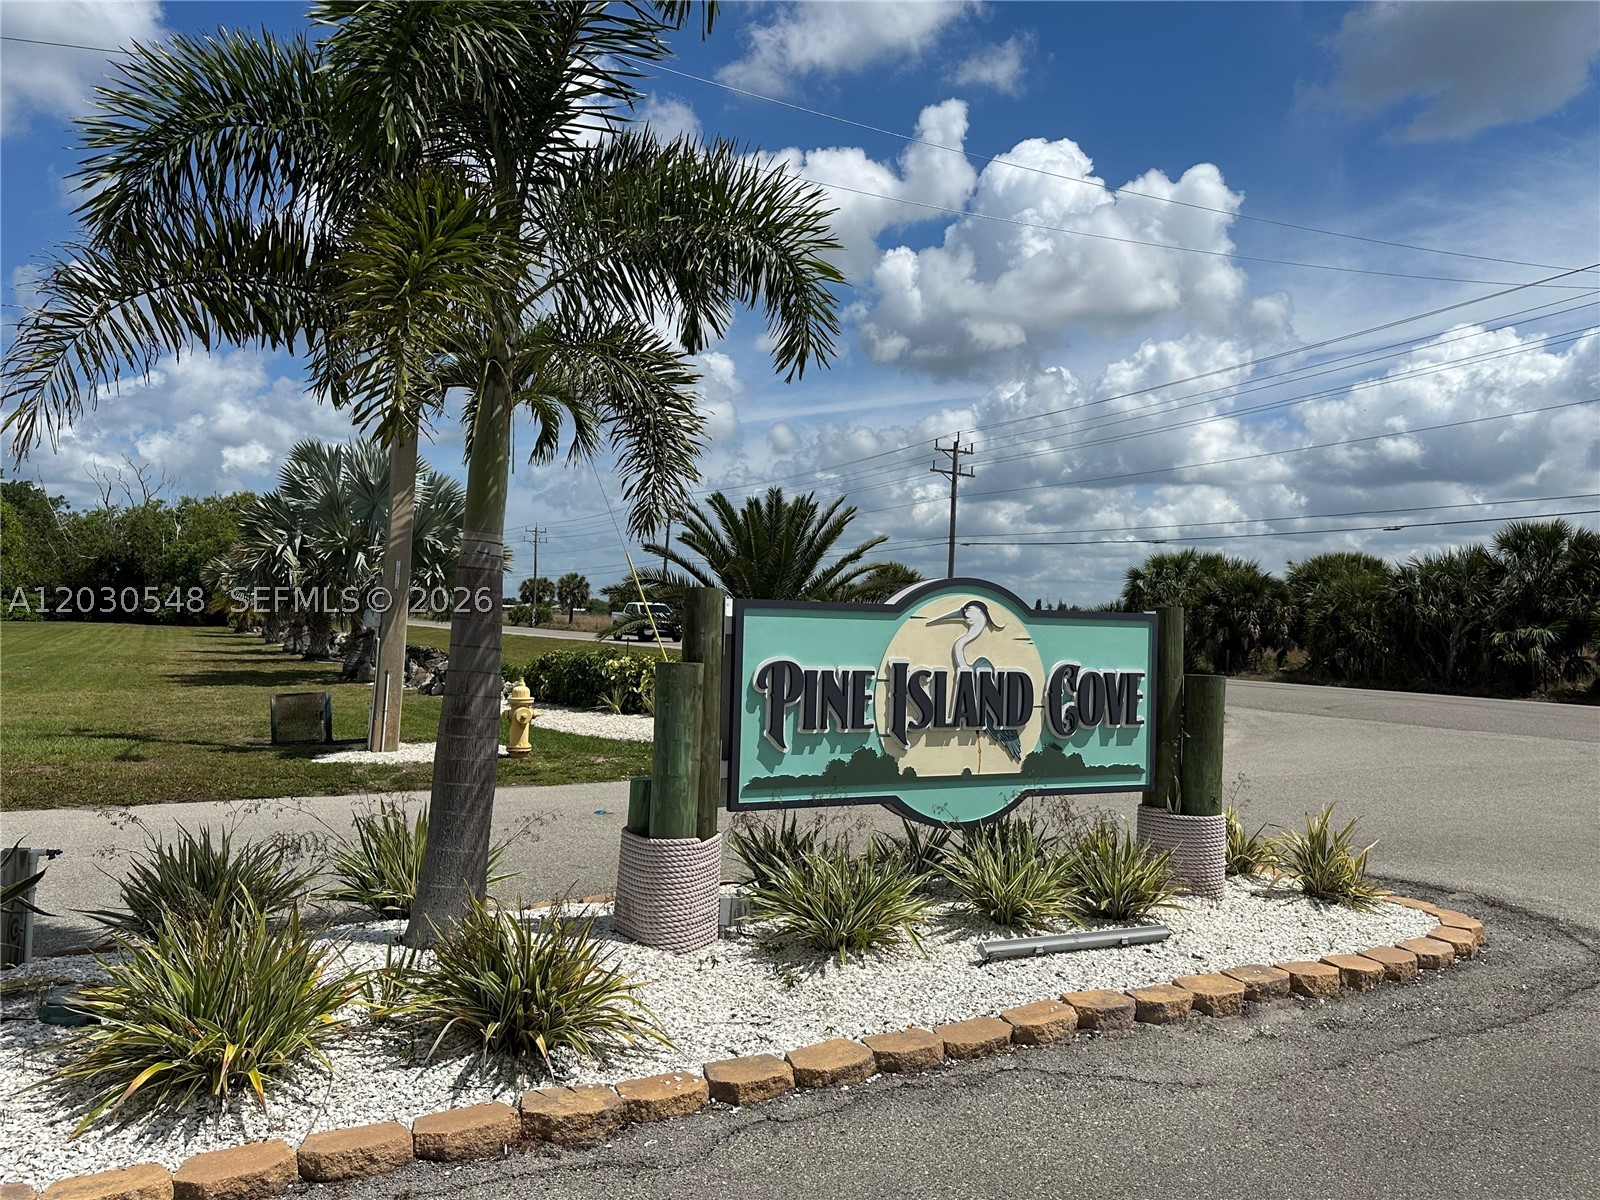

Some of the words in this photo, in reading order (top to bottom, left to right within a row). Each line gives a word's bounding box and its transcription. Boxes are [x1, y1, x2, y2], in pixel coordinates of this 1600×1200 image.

[754, 657, 876, 752] PINE
[888, 658, 1035, 750] ISLAND
[1045, 659, 1146, 739] COVE
